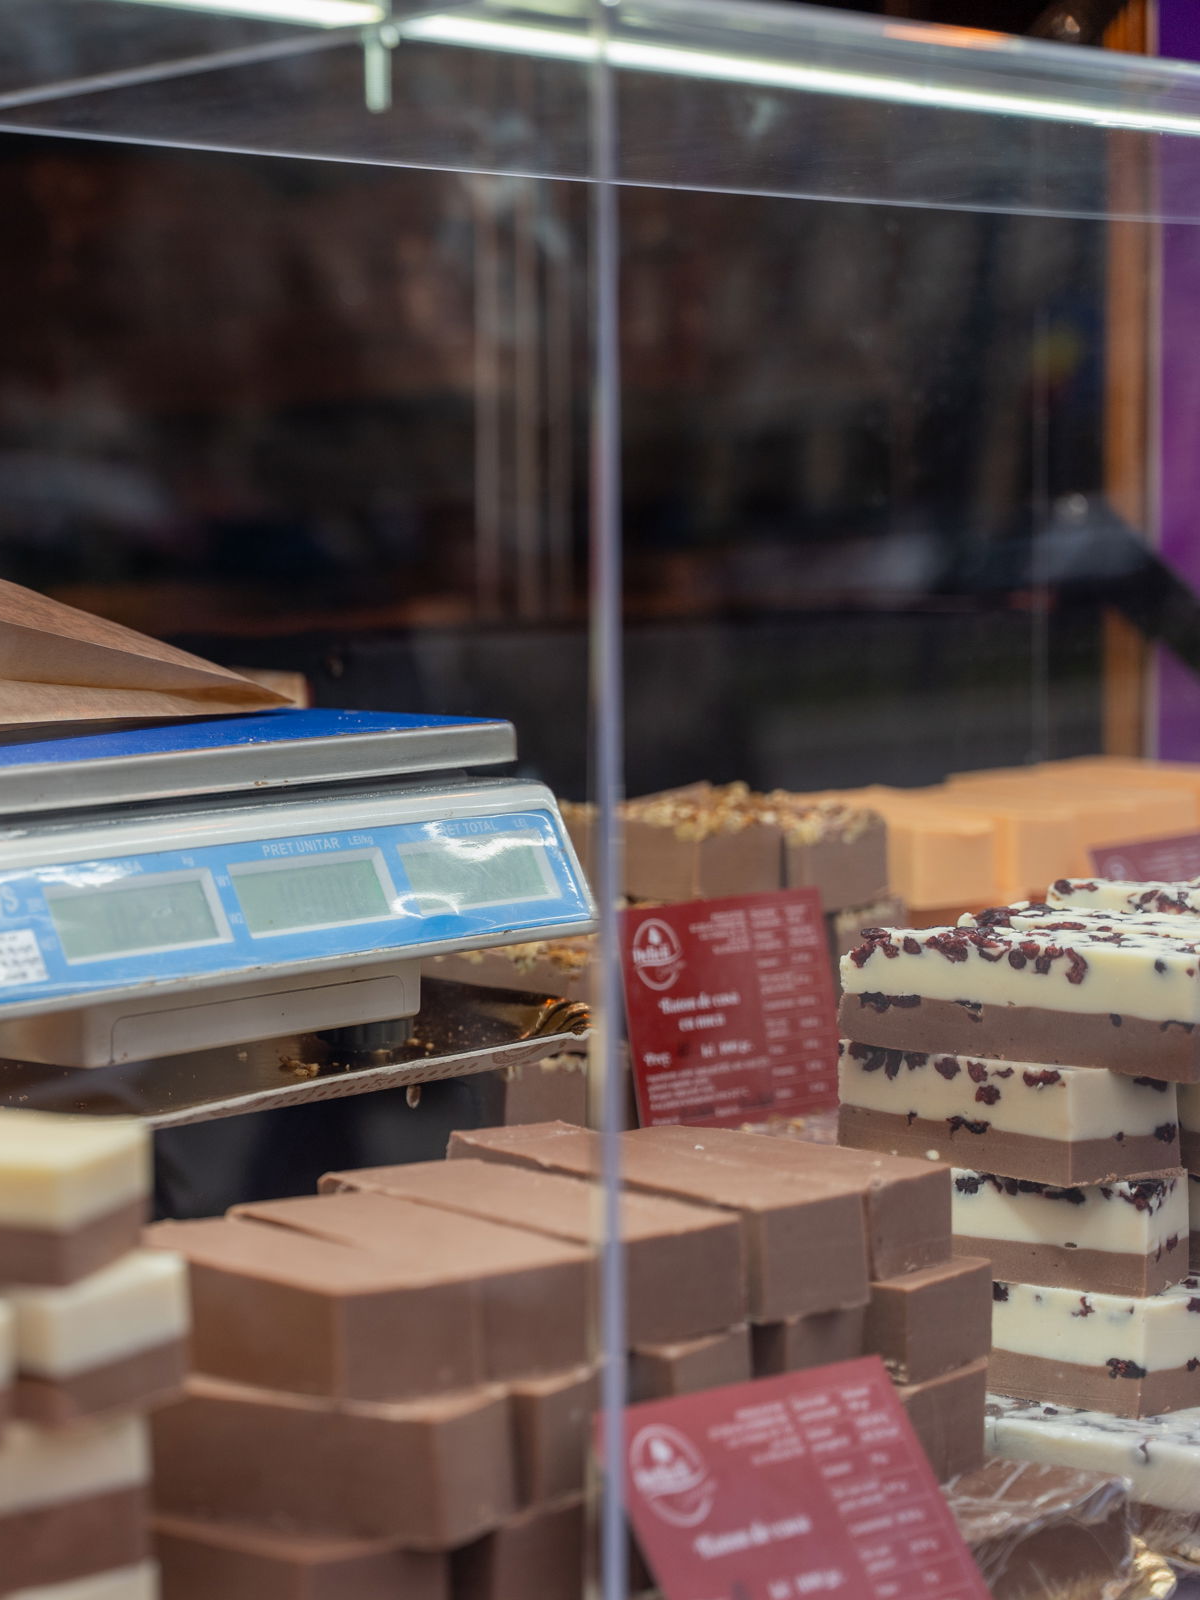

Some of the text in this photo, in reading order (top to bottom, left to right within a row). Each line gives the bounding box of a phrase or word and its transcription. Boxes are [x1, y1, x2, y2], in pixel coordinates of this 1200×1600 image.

[464, 820, 498, 833] TOTAL
[262, 843, 294, 857] PRET
[295, 837, 341, 853] UNITAR
